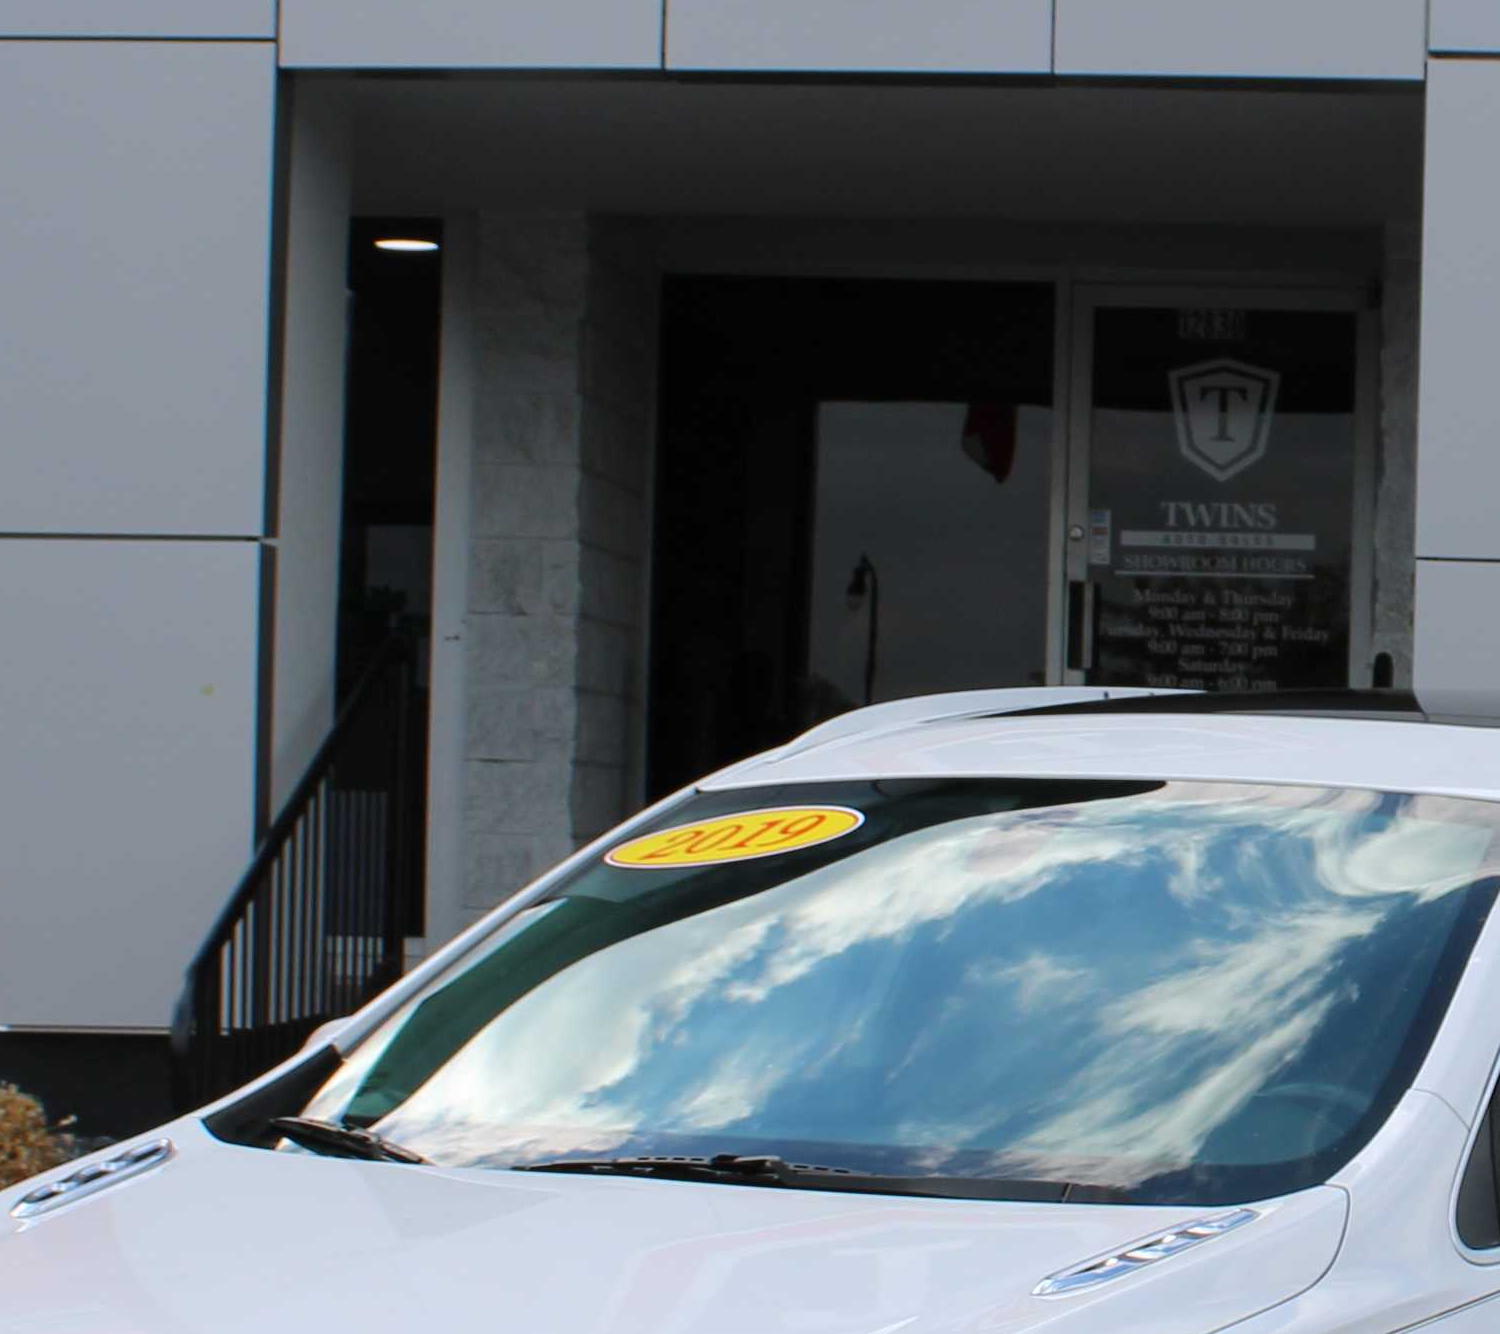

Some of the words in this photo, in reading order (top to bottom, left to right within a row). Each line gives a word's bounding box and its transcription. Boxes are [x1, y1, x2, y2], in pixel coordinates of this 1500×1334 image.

[1201, 386, 1248, 443] T
[1161, 501, 1277, 529] TWINS
[1222, 589, 1292, 608] Thursday
[638, 813, 827, 860] 2019
